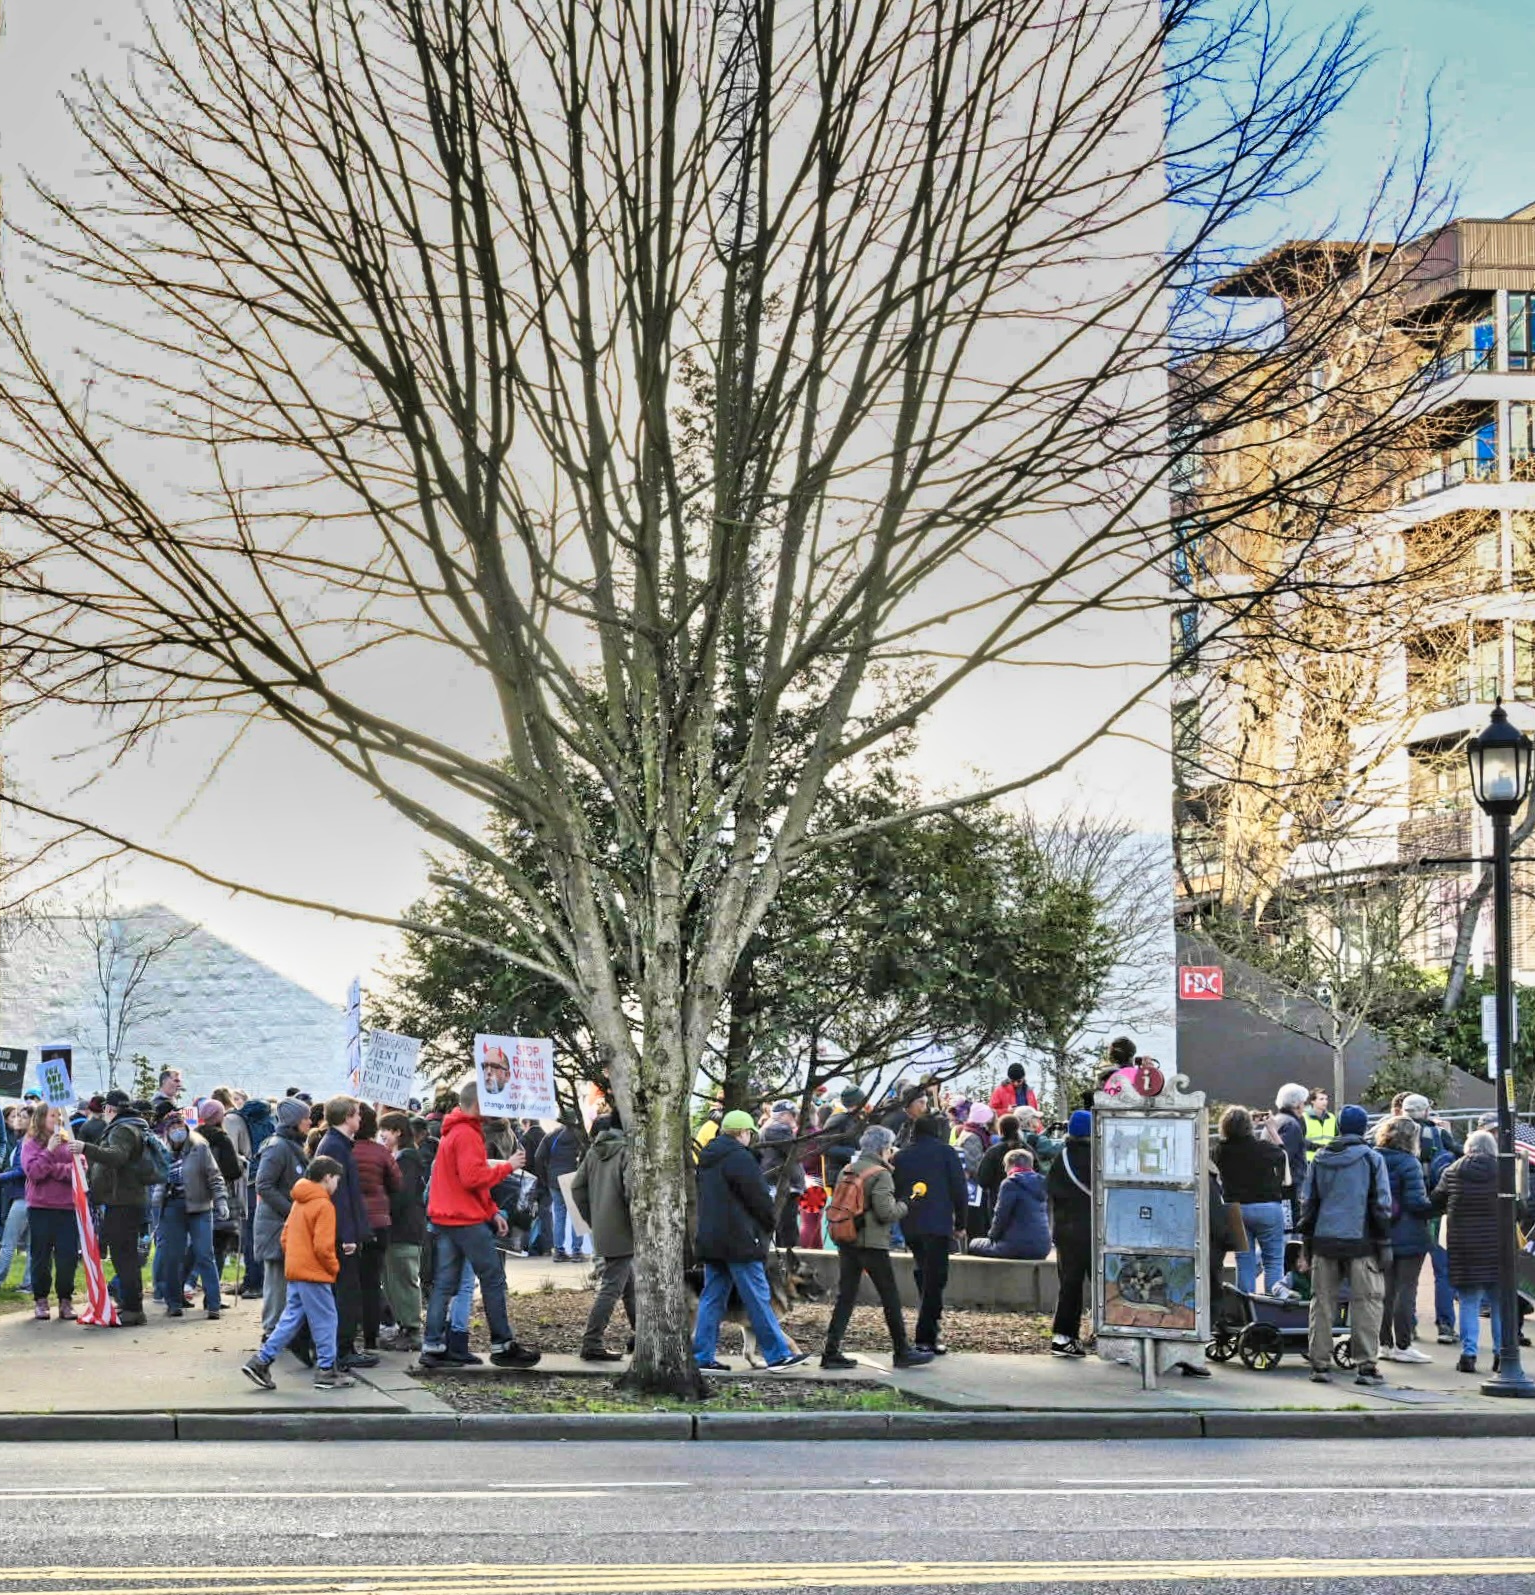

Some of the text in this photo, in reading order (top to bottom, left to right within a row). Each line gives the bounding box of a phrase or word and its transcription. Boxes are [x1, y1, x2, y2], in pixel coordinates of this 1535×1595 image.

[1184, 972, 1219, 993] FDC
[515, 1044, 540, 1057] STOP
[512, 1056, 544, 1070] Russell
[513, 1068, 545, 1084] Vought
